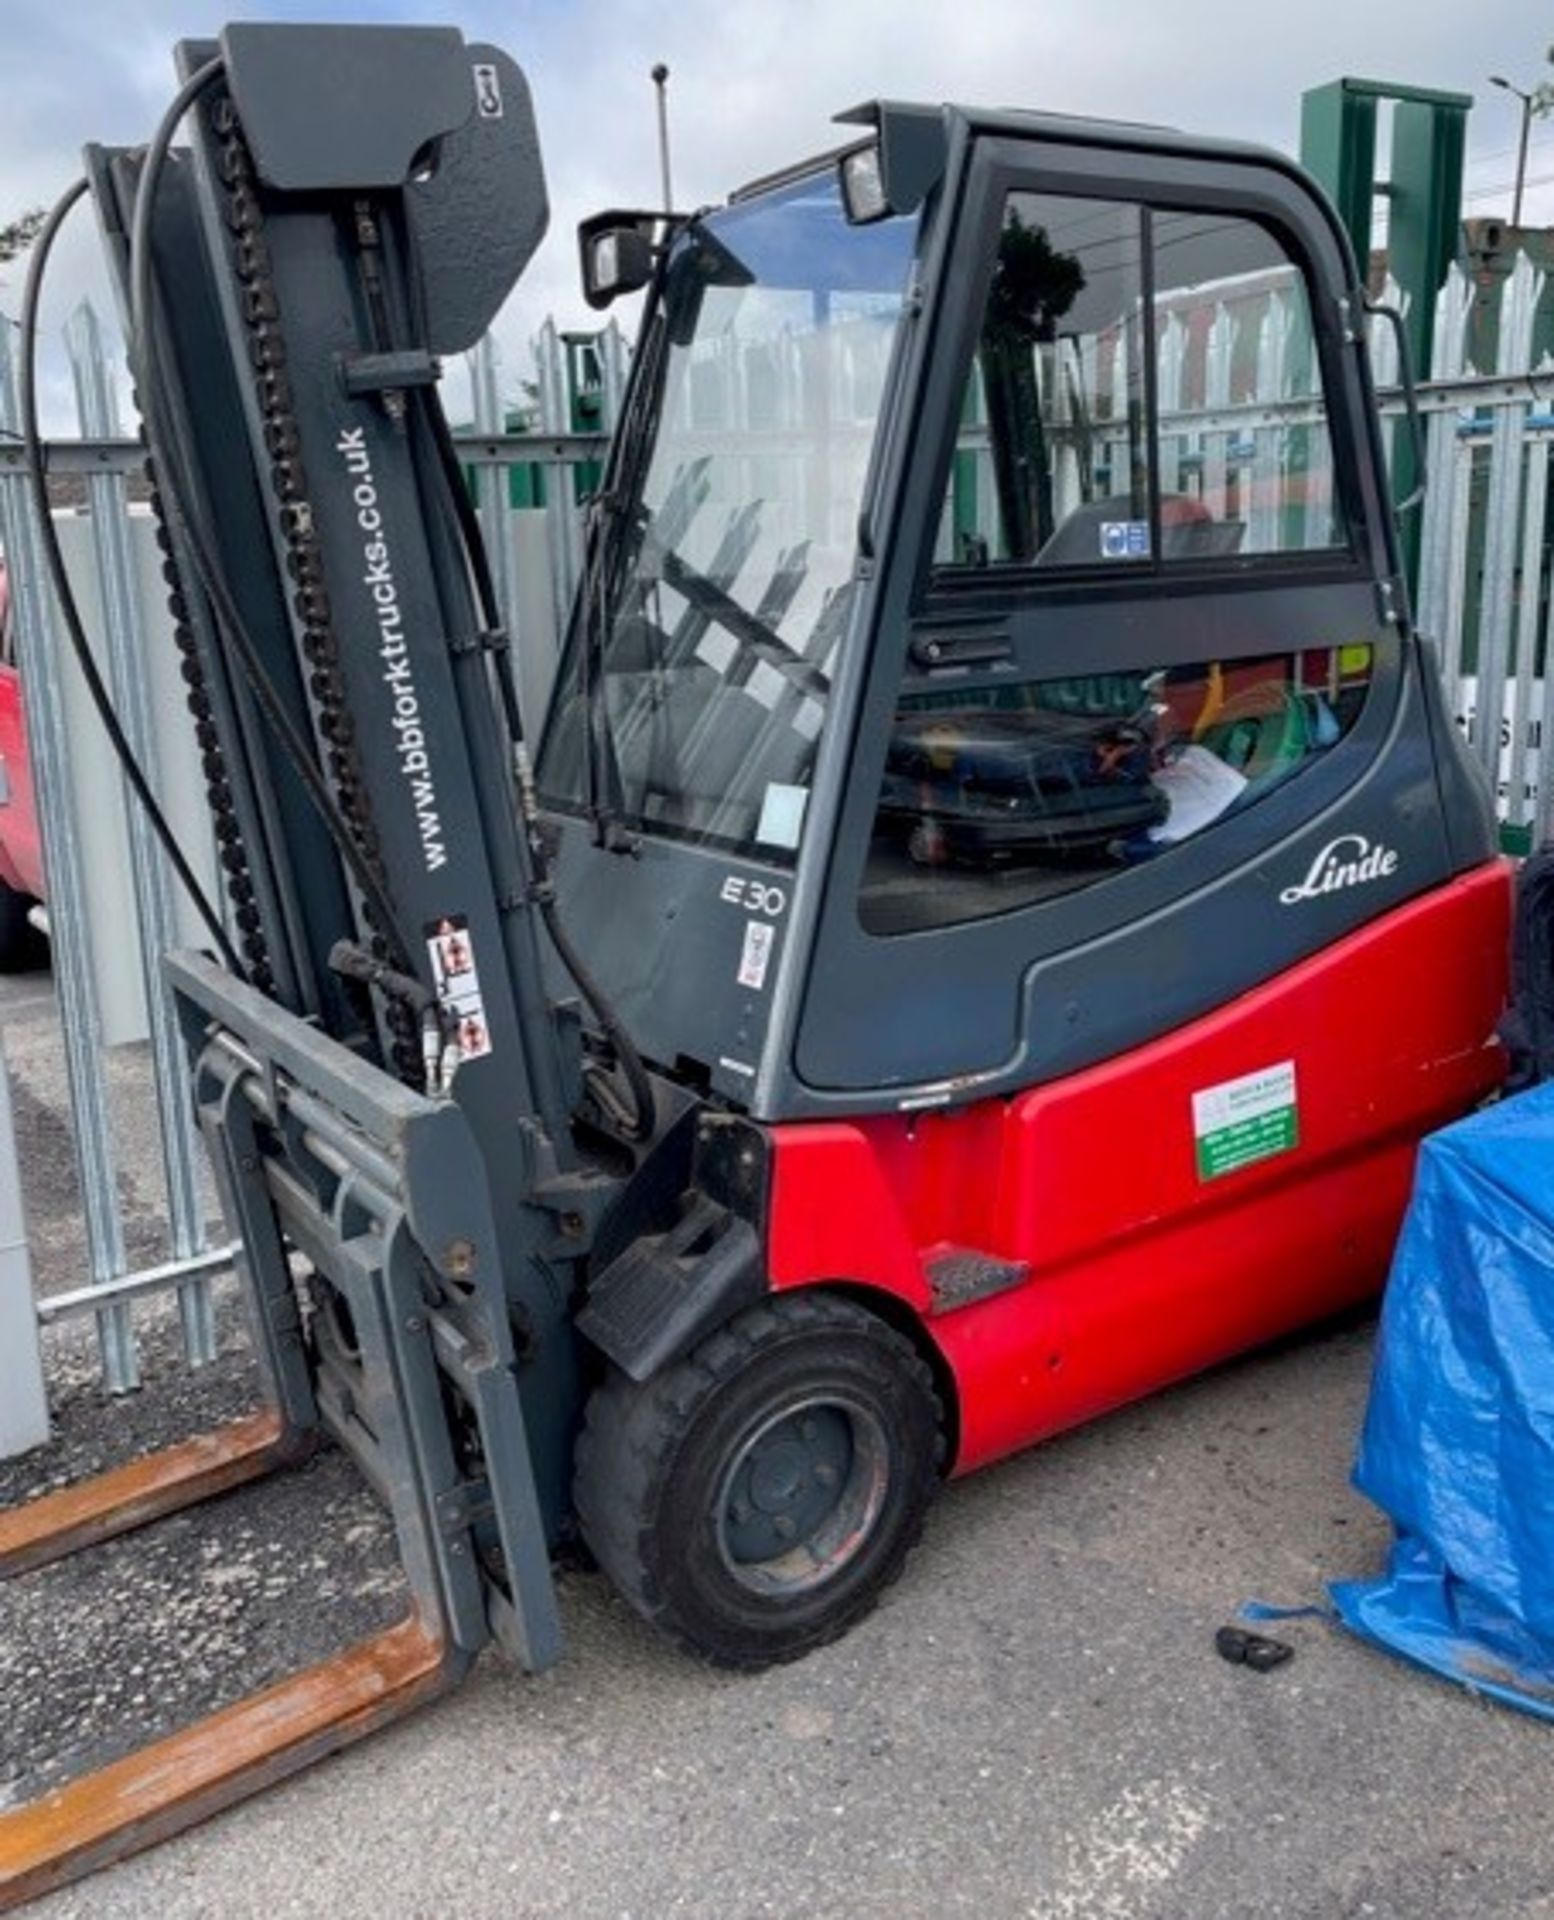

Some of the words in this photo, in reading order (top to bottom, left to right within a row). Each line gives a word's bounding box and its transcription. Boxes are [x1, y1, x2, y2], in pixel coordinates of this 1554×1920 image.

[337, 426, 447, 871] www.bbforktrucks.co.uk
[720, 876, 786, 916] E30
[1280, 833, 1398, 904] Linde
